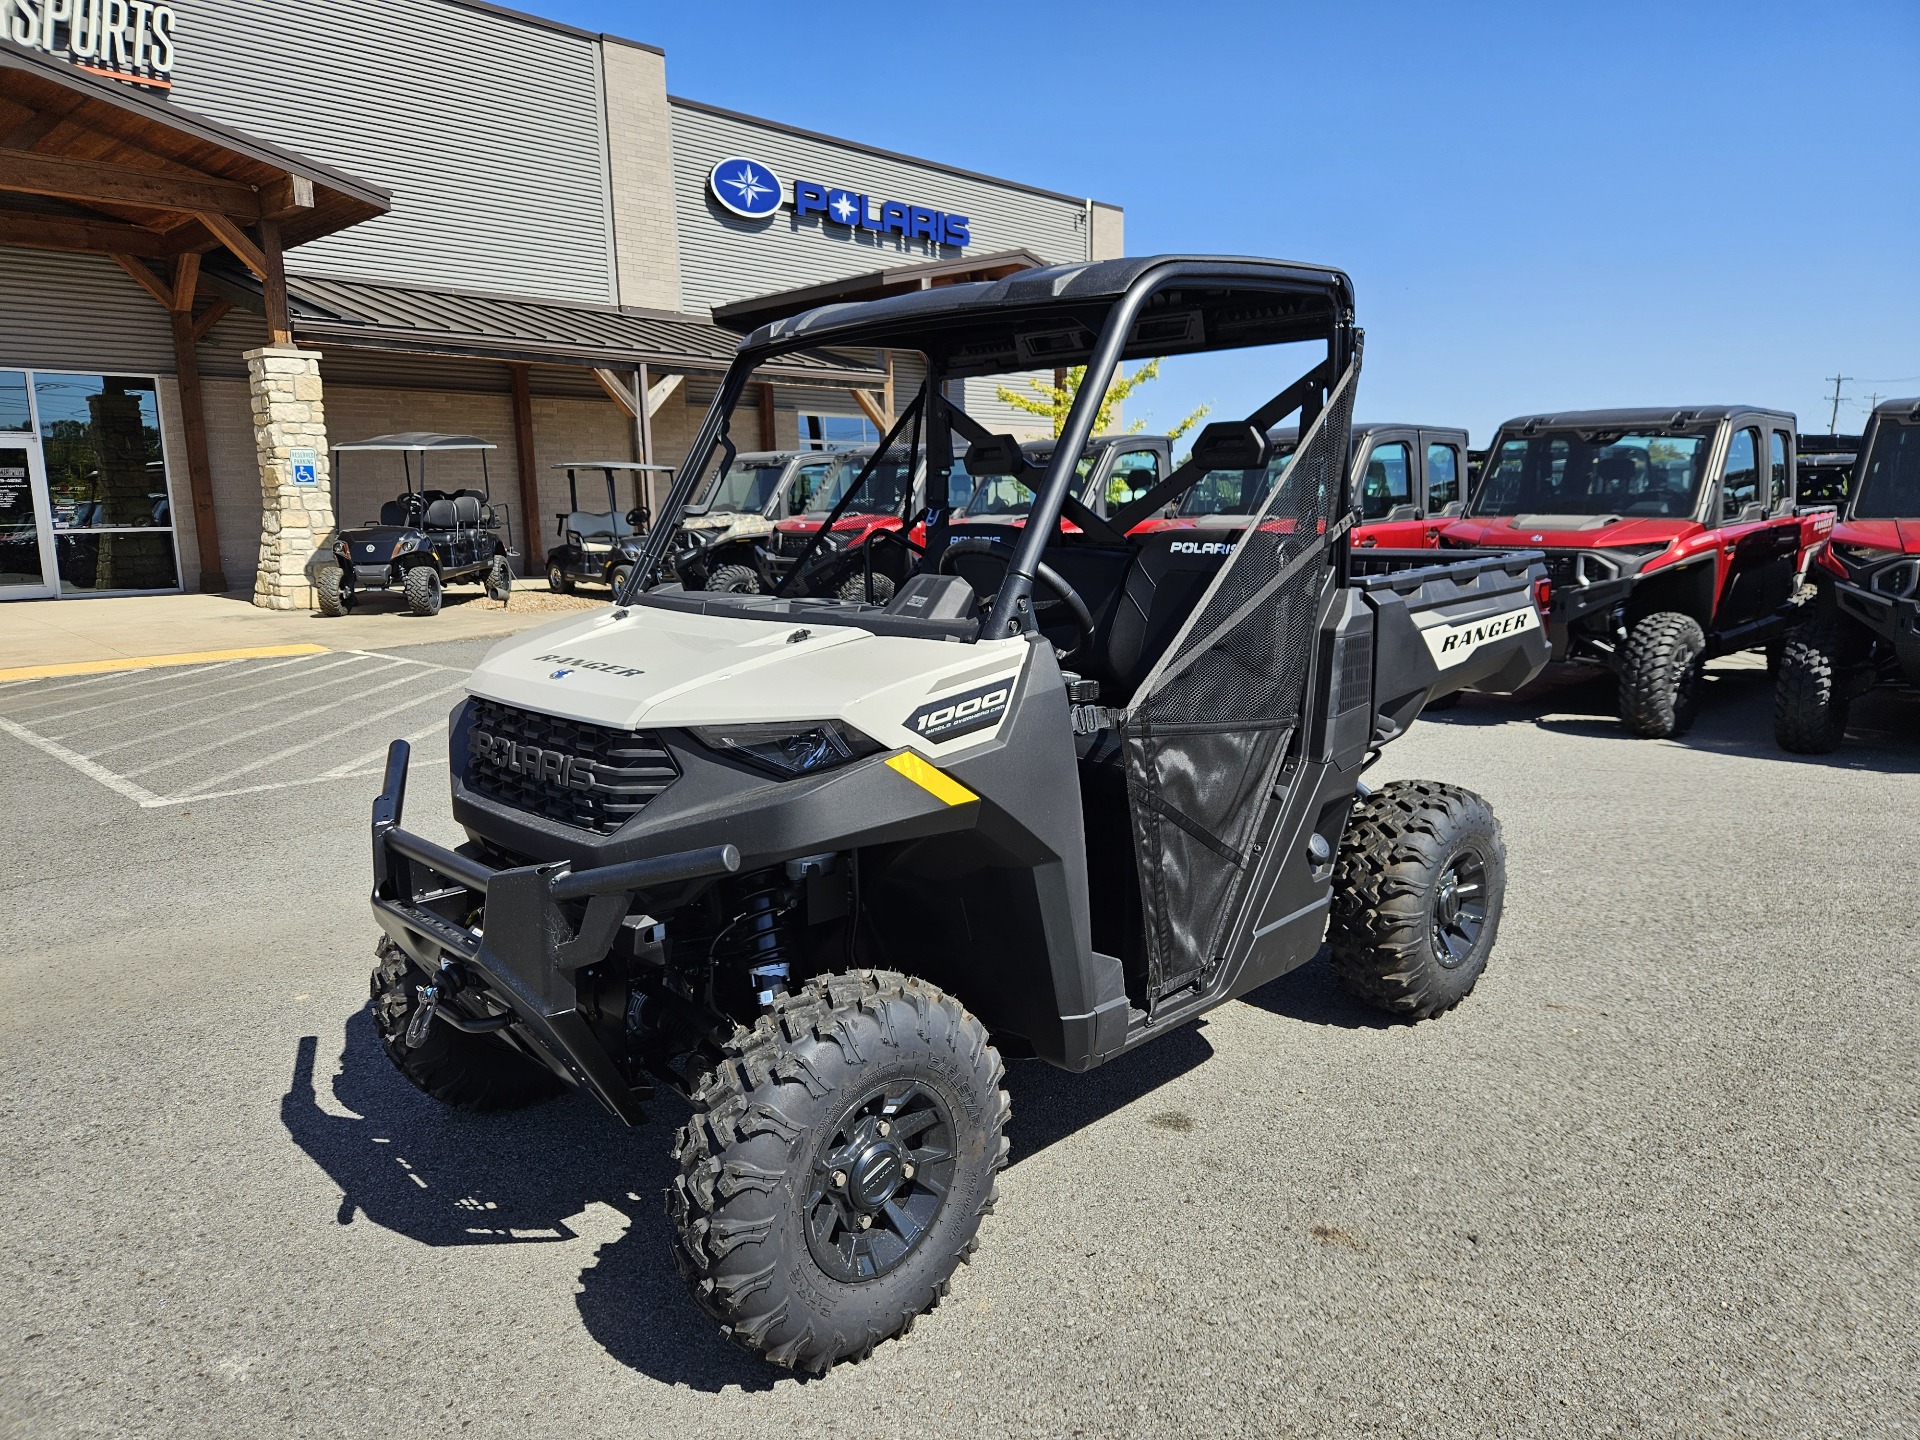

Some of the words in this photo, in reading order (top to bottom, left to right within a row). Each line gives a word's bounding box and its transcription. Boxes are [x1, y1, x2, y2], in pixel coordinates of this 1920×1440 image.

[0, 0, 175, 73] SPORTS
[794, 179, 970, 247] POLARIS
[1441, 613, 1528, 653] RANGER
[532, 654, 646, 678] RANGER
[917, 688, 1007, 731] 1000
[925, 722, 951, 735] SINGLE
[953, 709, 990, 726] OVERHEAD
[476, 730, 596, 792] POLARIS
